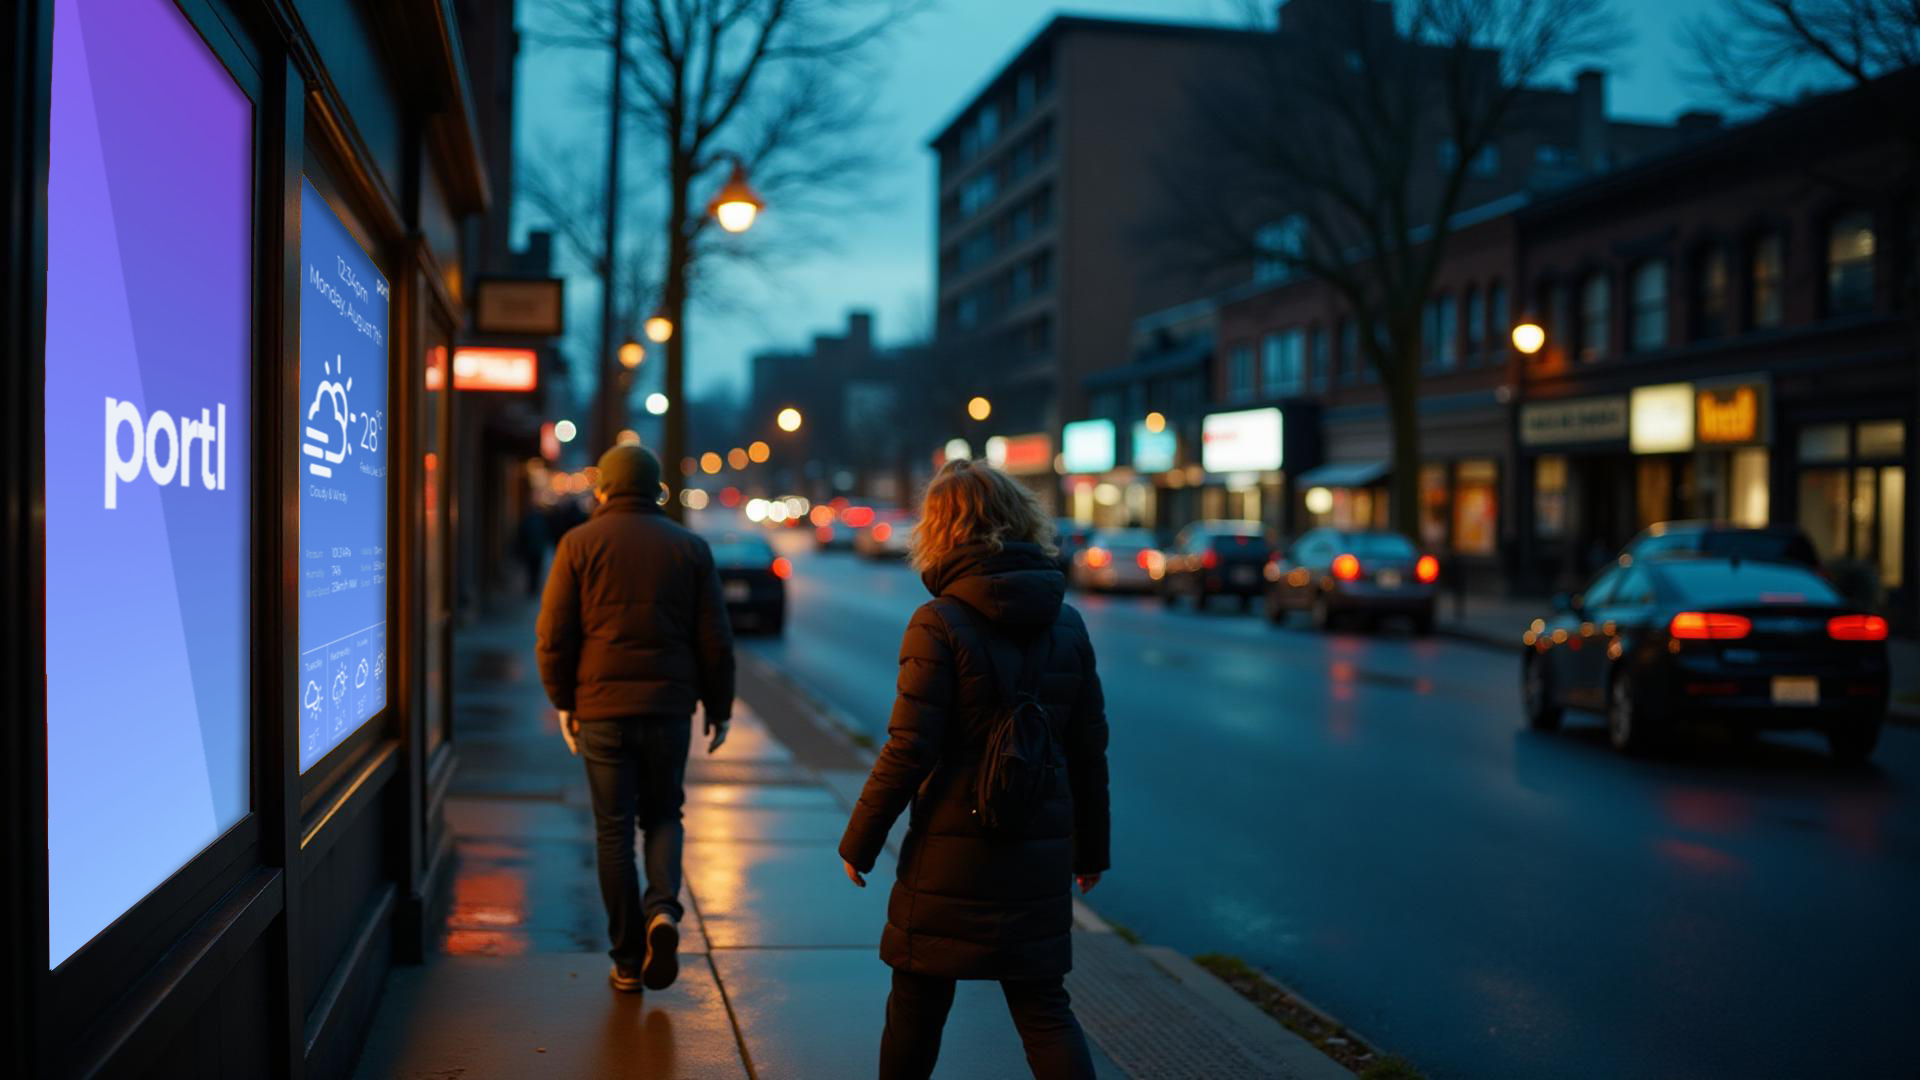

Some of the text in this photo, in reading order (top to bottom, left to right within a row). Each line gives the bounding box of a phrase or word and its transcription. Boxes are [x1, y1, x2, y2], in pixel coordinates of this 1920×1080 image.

[310, 263, 346, 318] Monday,
[347, 302, 372, 338] August
[105, 396, 226, 510] portl
